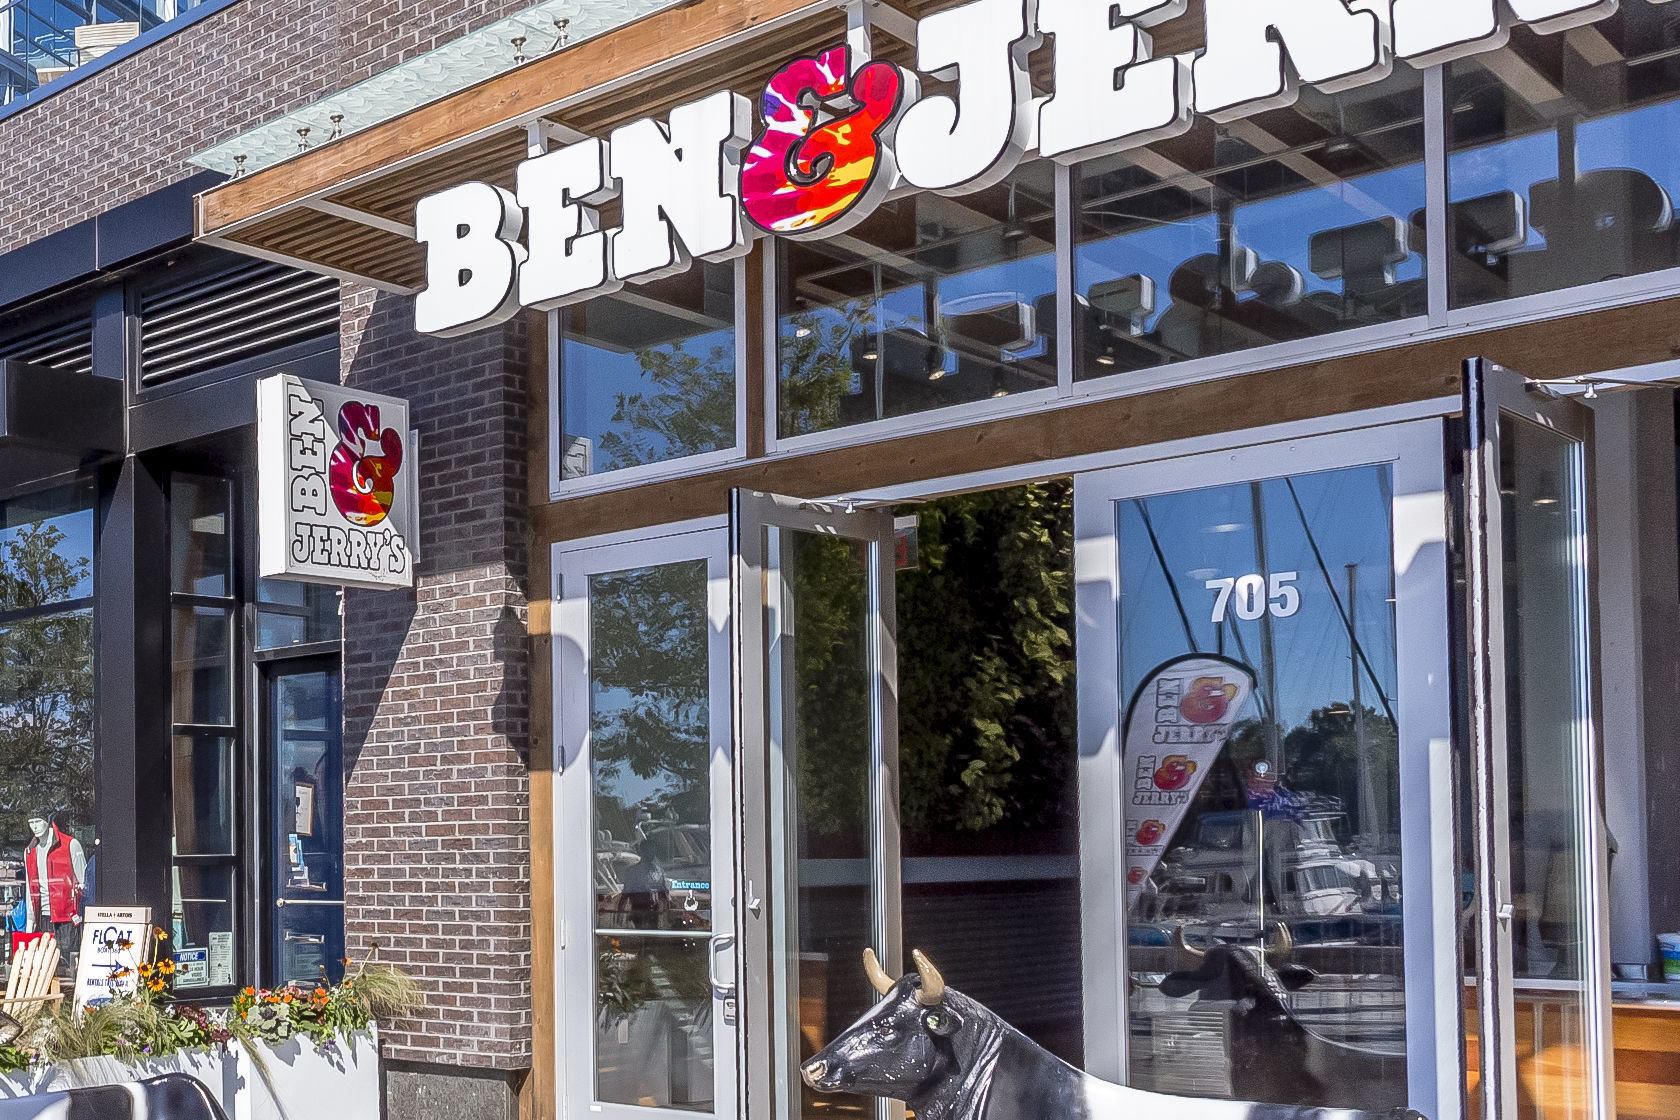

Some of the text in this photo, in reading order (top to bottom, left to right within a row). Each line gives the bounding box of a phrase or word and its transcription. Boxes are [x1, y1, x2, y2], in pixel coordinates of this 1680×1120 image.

[414, 89, 752, 337] BEN
[739, 44, 912, 240] &
[289, 394, 327, 516] BEN
[292, 522, 406, 574] JERRY'S
[1205, 571, 1300, 623] 705
[671, 880, 710, 889] Entrance
[179, 952, 199, 961] NOTICE
